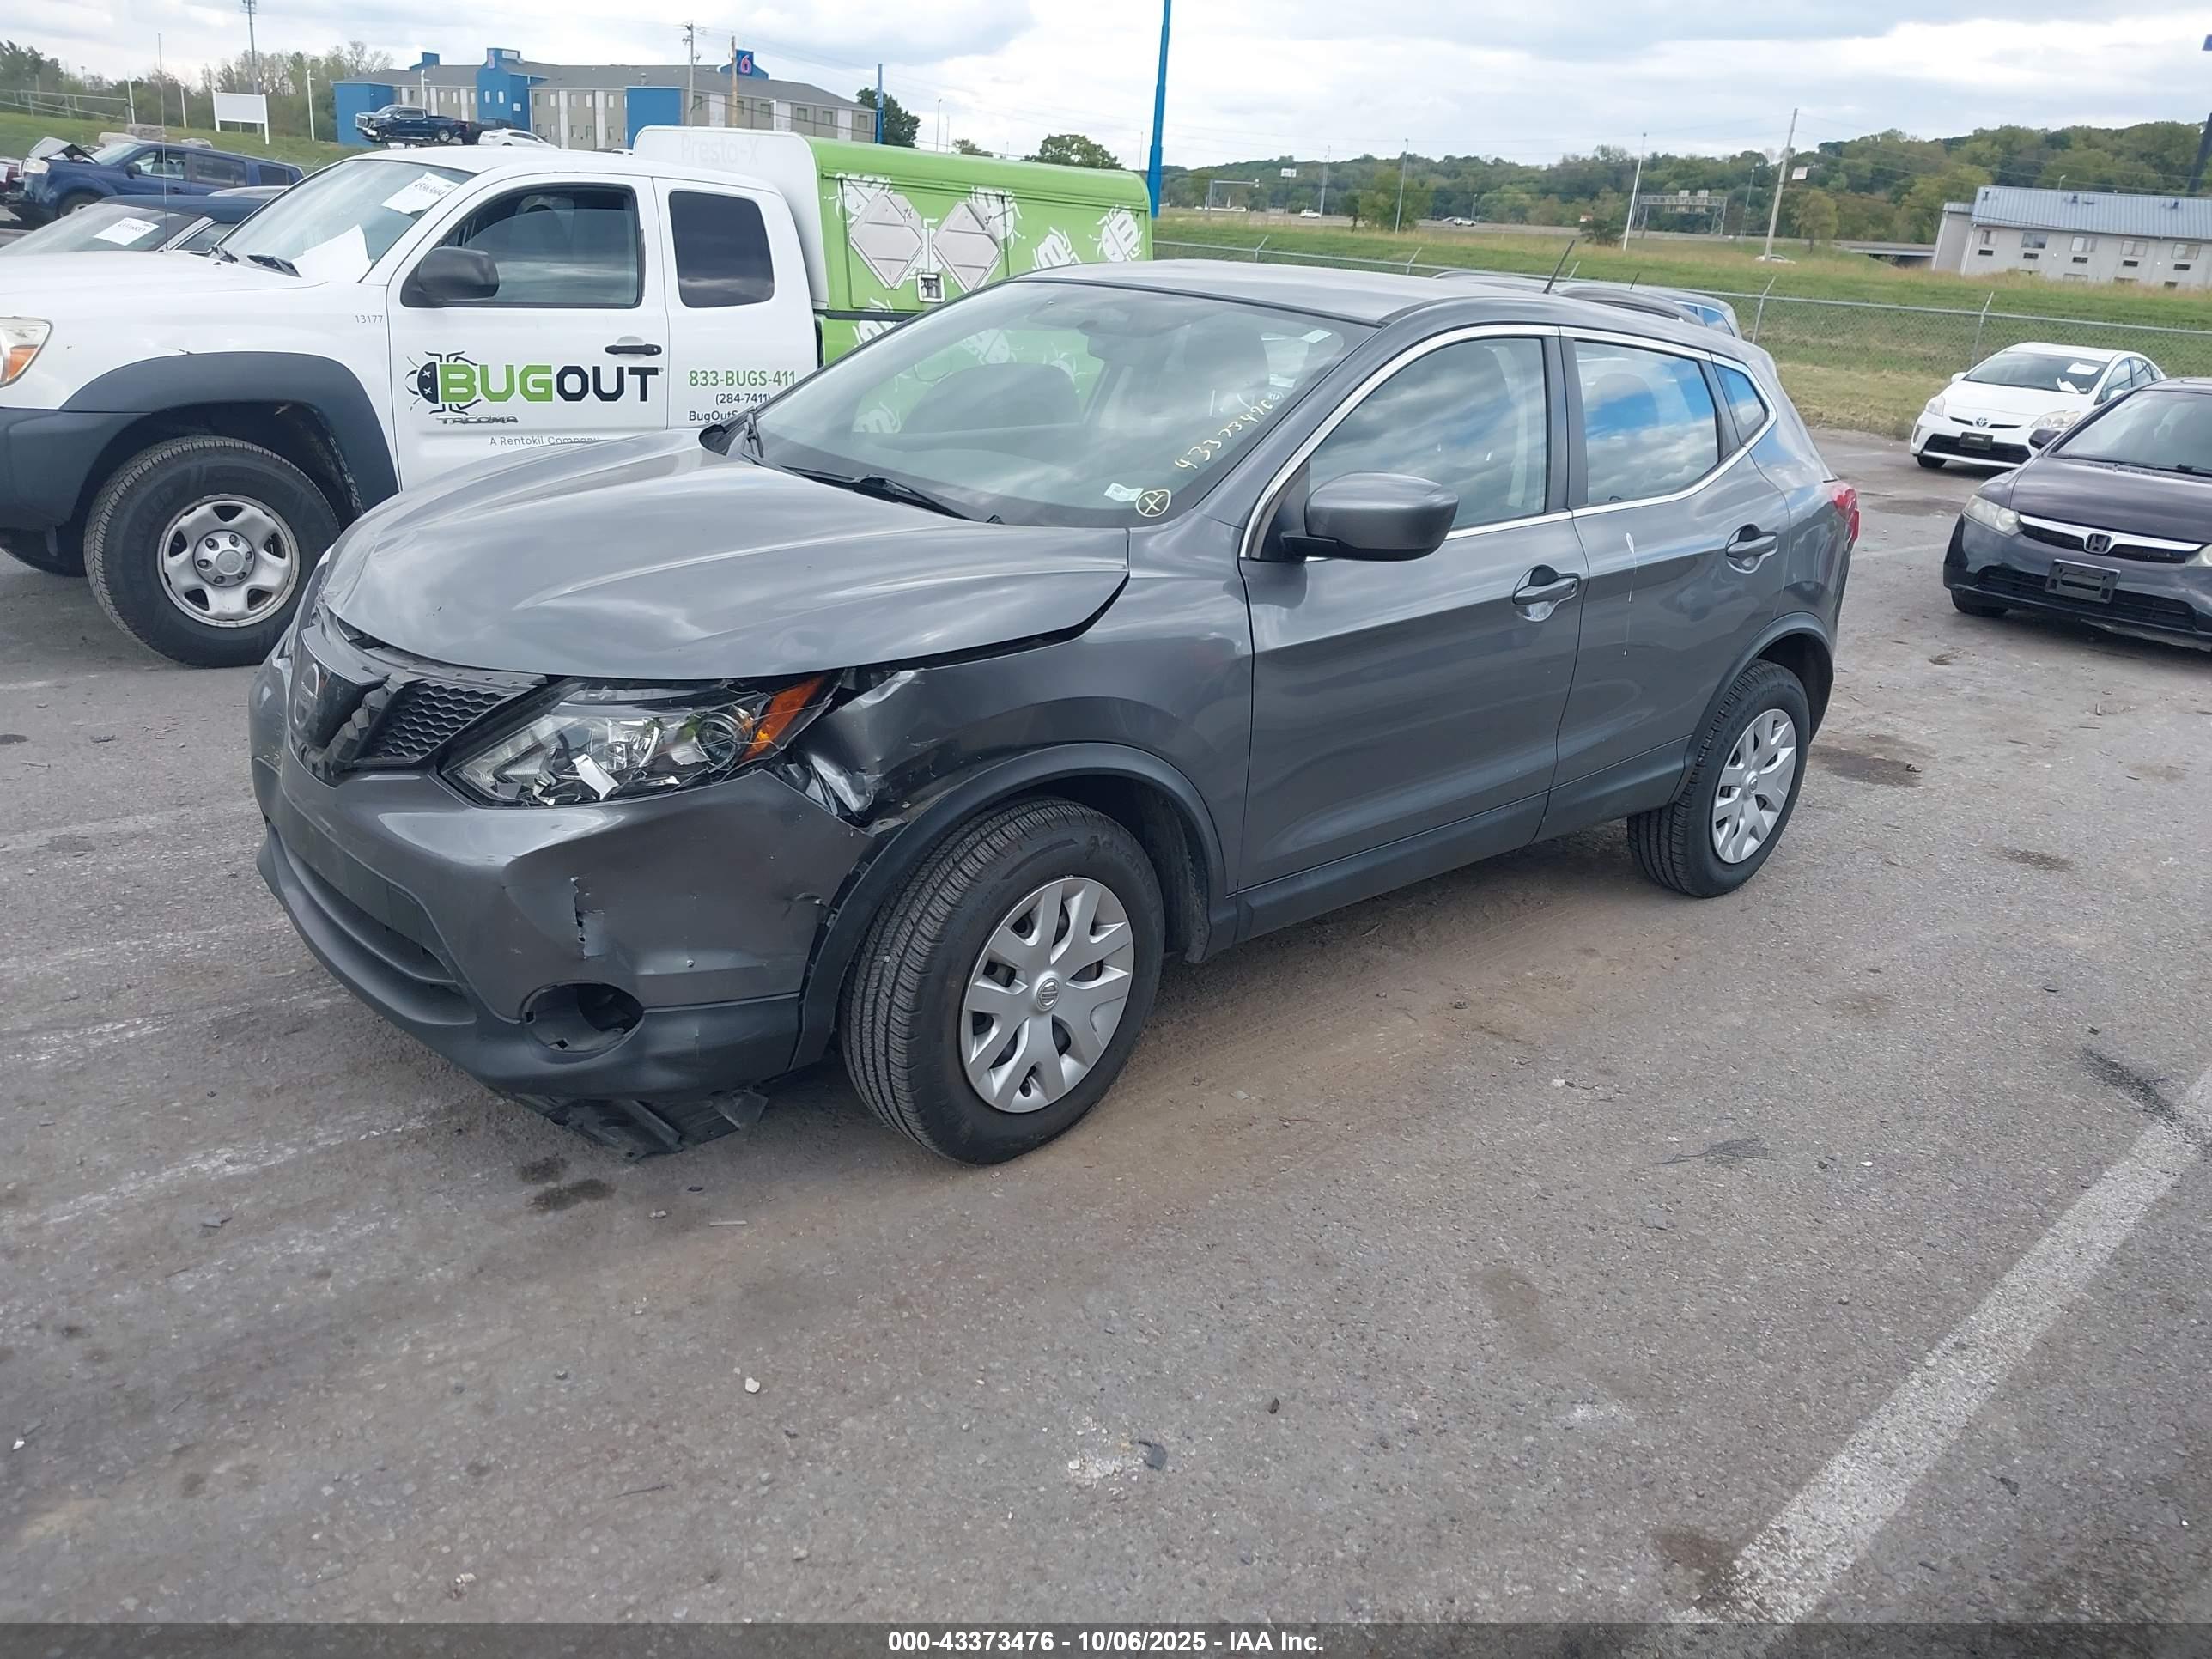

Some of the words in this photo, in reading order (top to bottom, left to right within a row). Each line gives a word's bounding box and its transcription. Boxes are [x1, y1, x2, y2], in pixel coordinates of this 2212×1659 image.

[355, 314, 383, 324] 13177
[439, 364, 659, 402] BUGOUT
[689, 370, 795, 386] 833-BUGS-411
[437, 415, 519, 425] TACOMA
[490, 437, 497, 446] A
[500, 435, 544, 446] Rentokil
